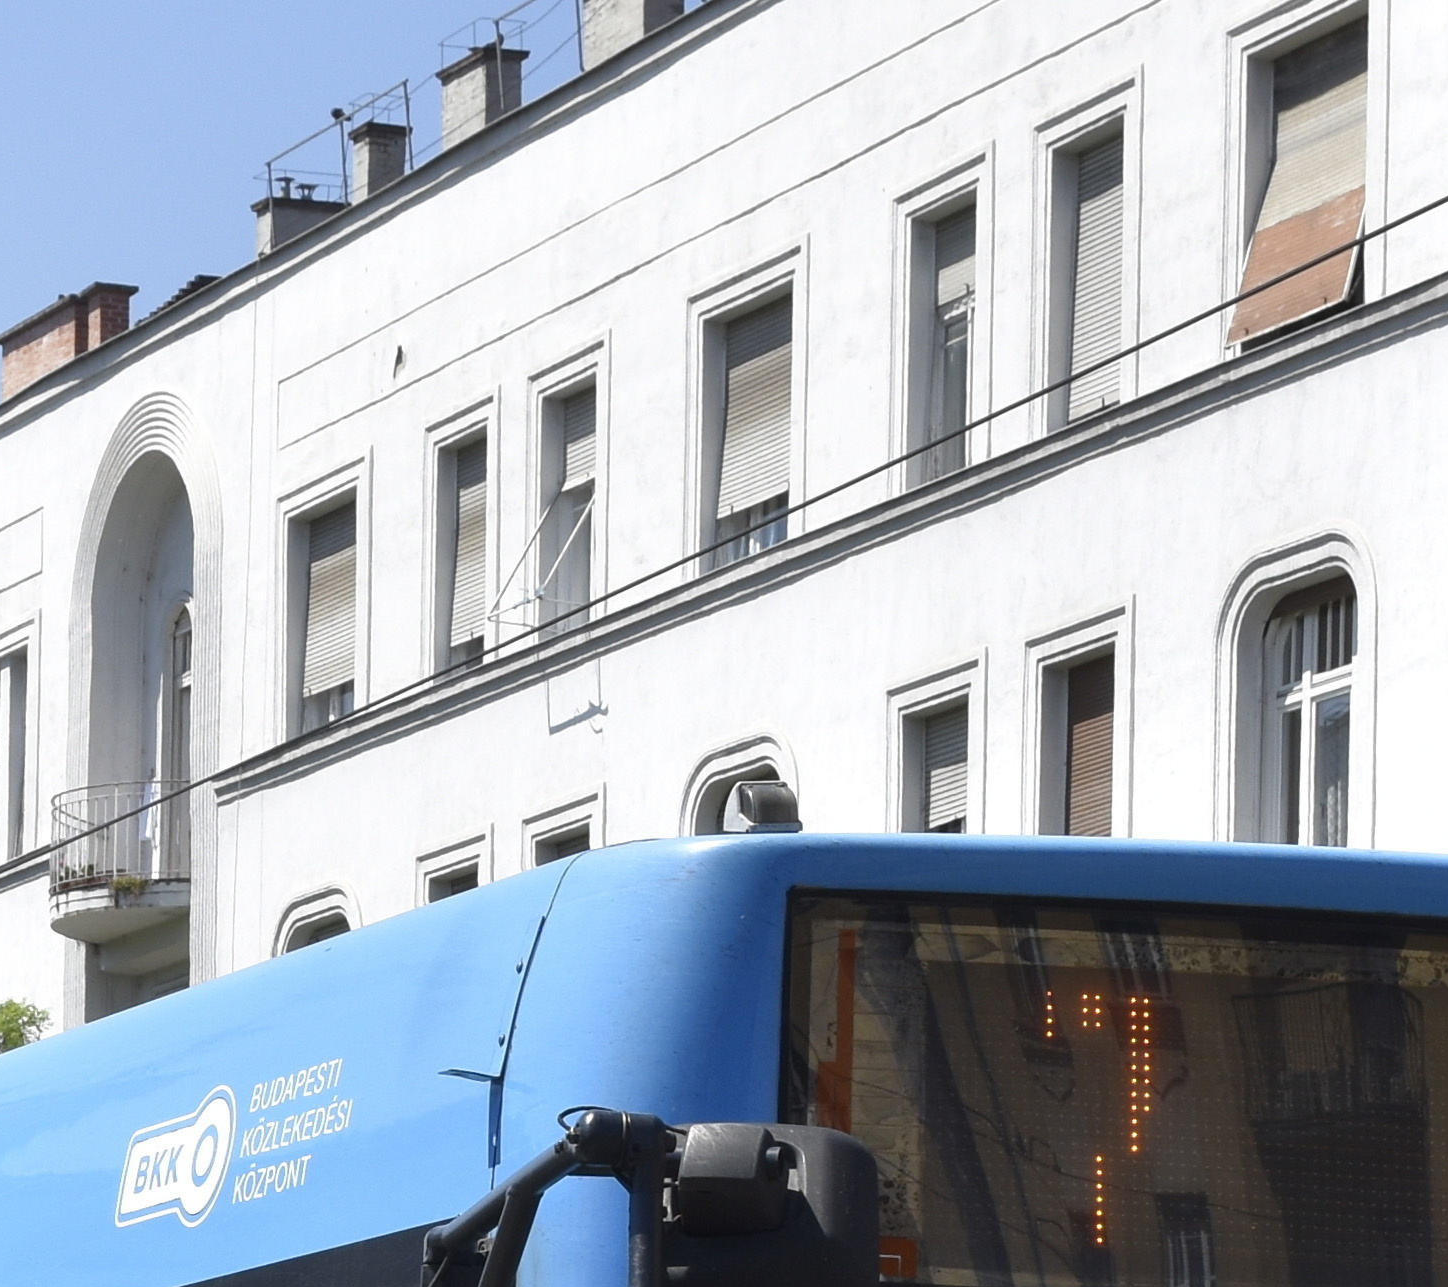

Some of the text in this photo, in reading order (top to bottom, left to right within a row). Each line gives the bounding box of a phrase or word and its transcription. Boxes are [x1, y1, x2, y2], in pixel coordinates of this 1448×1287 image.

[133, 1058, 343, 1195] BKK BUDAPESTI
[239, 1095, 353, 1159] KÖZLEKEDÉSI
[232, 1154, 312, 1205] KÖZPONT
